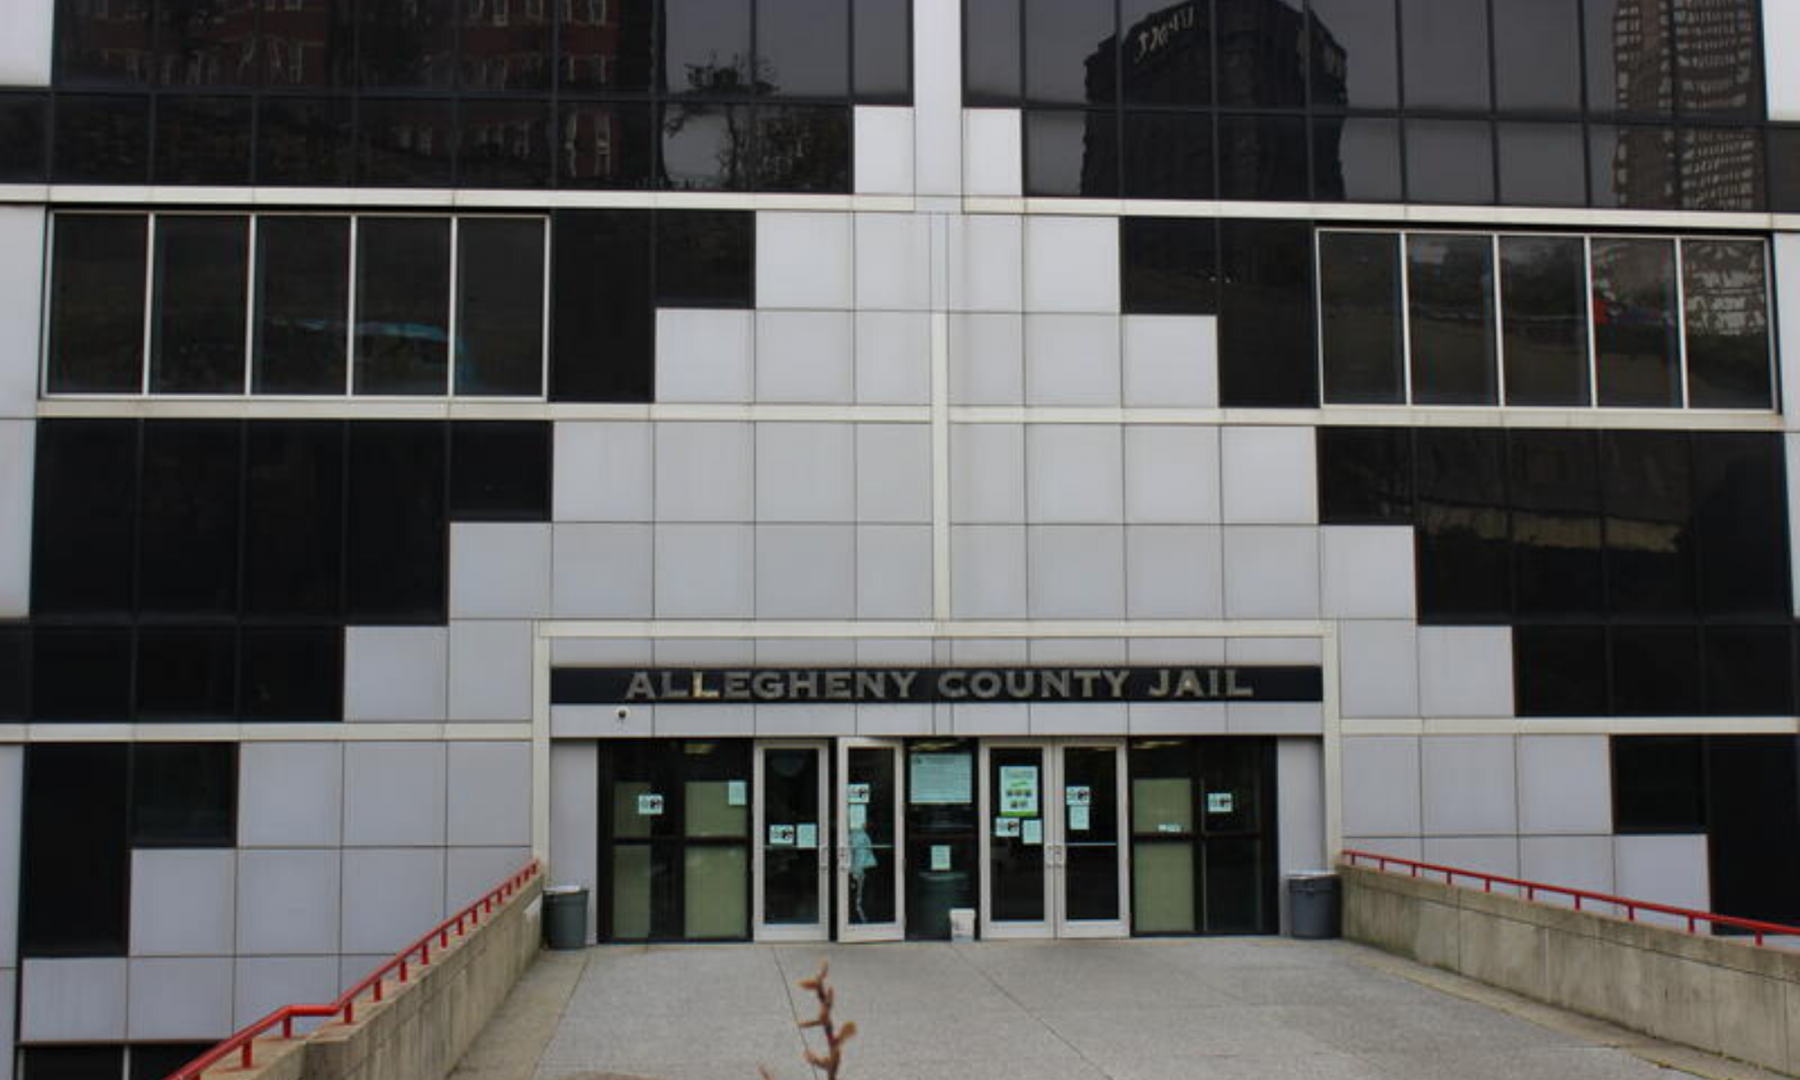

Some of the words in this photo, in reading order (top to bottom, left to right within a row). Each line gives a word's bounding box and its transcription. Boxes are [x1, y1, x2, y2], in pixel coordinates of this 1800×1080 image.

[625, 671, 917, 699] ALLEGHENY
[938, 670, 1130, 698] COUNTY
[1149, 669, 1254, 698] JAIL
